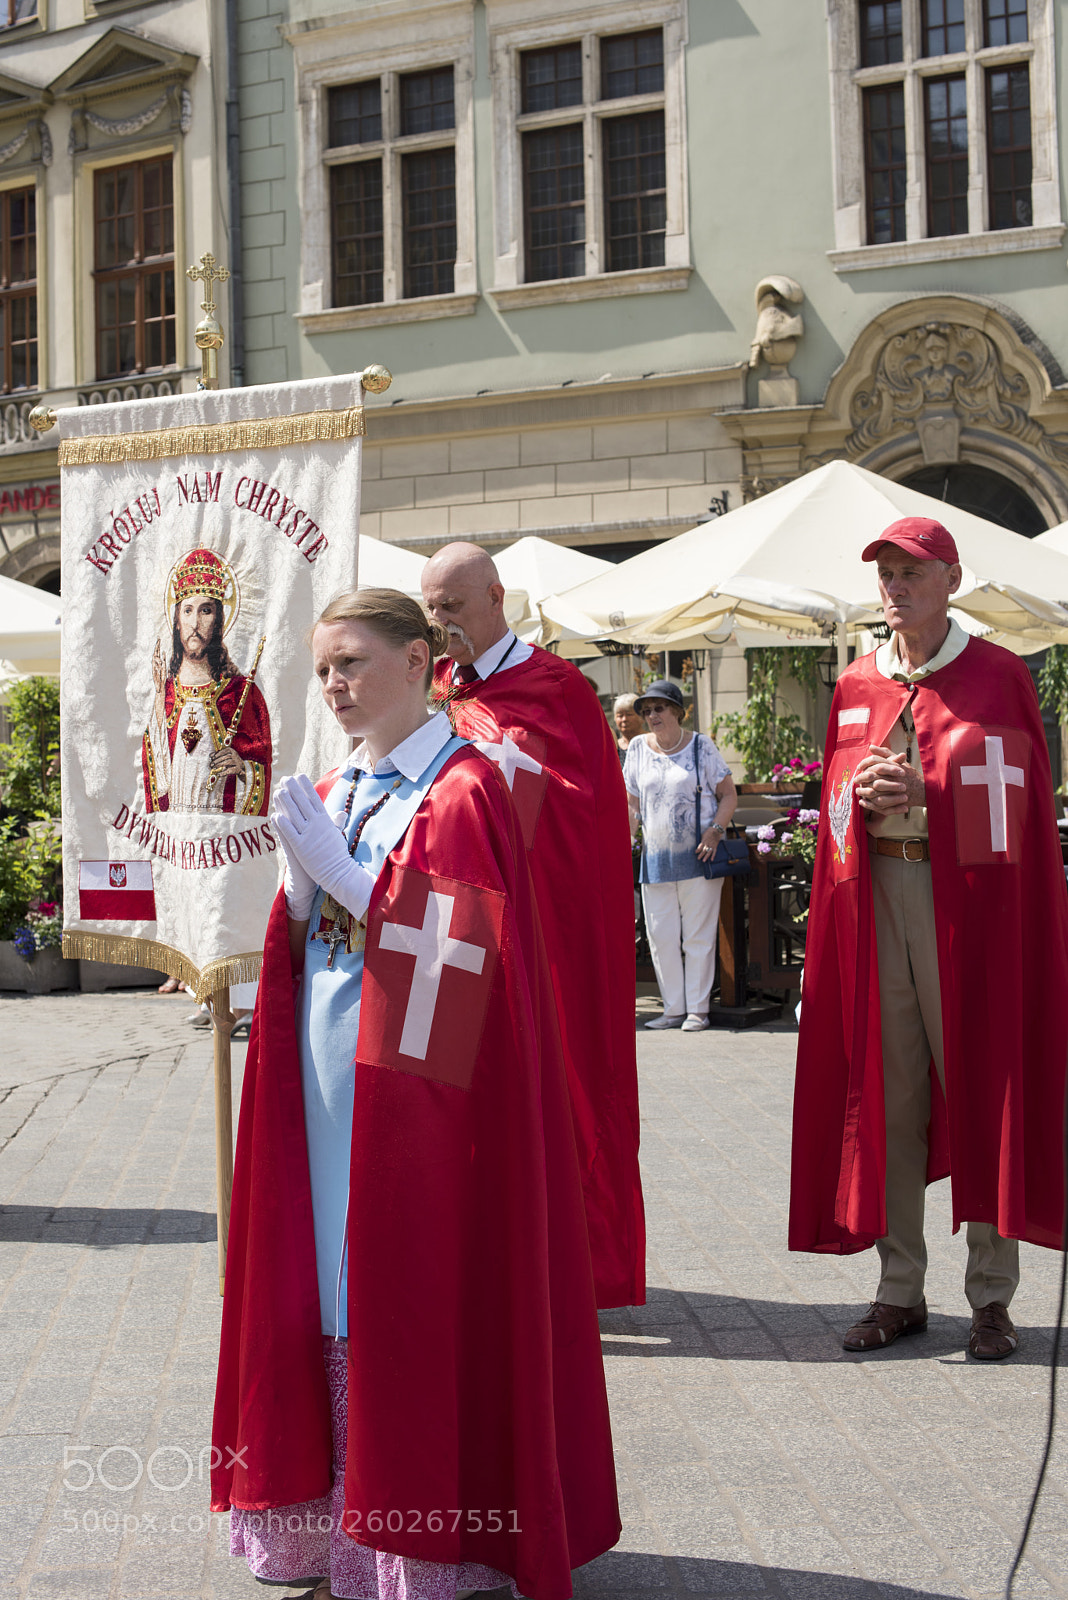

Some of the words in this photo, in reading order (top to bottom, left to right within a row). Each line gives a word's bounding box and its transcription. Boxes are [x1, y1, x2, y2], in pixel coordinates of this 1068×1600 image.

[85, 487, 161, 576] KRÓLUJ
[176, 471, 223, 506] NAM
[235, 476, 329, 564] CHRYSTE
[112, 803, 177, 867] DYWIZJA
[180, 821, 277, 870] KRAKOWS
